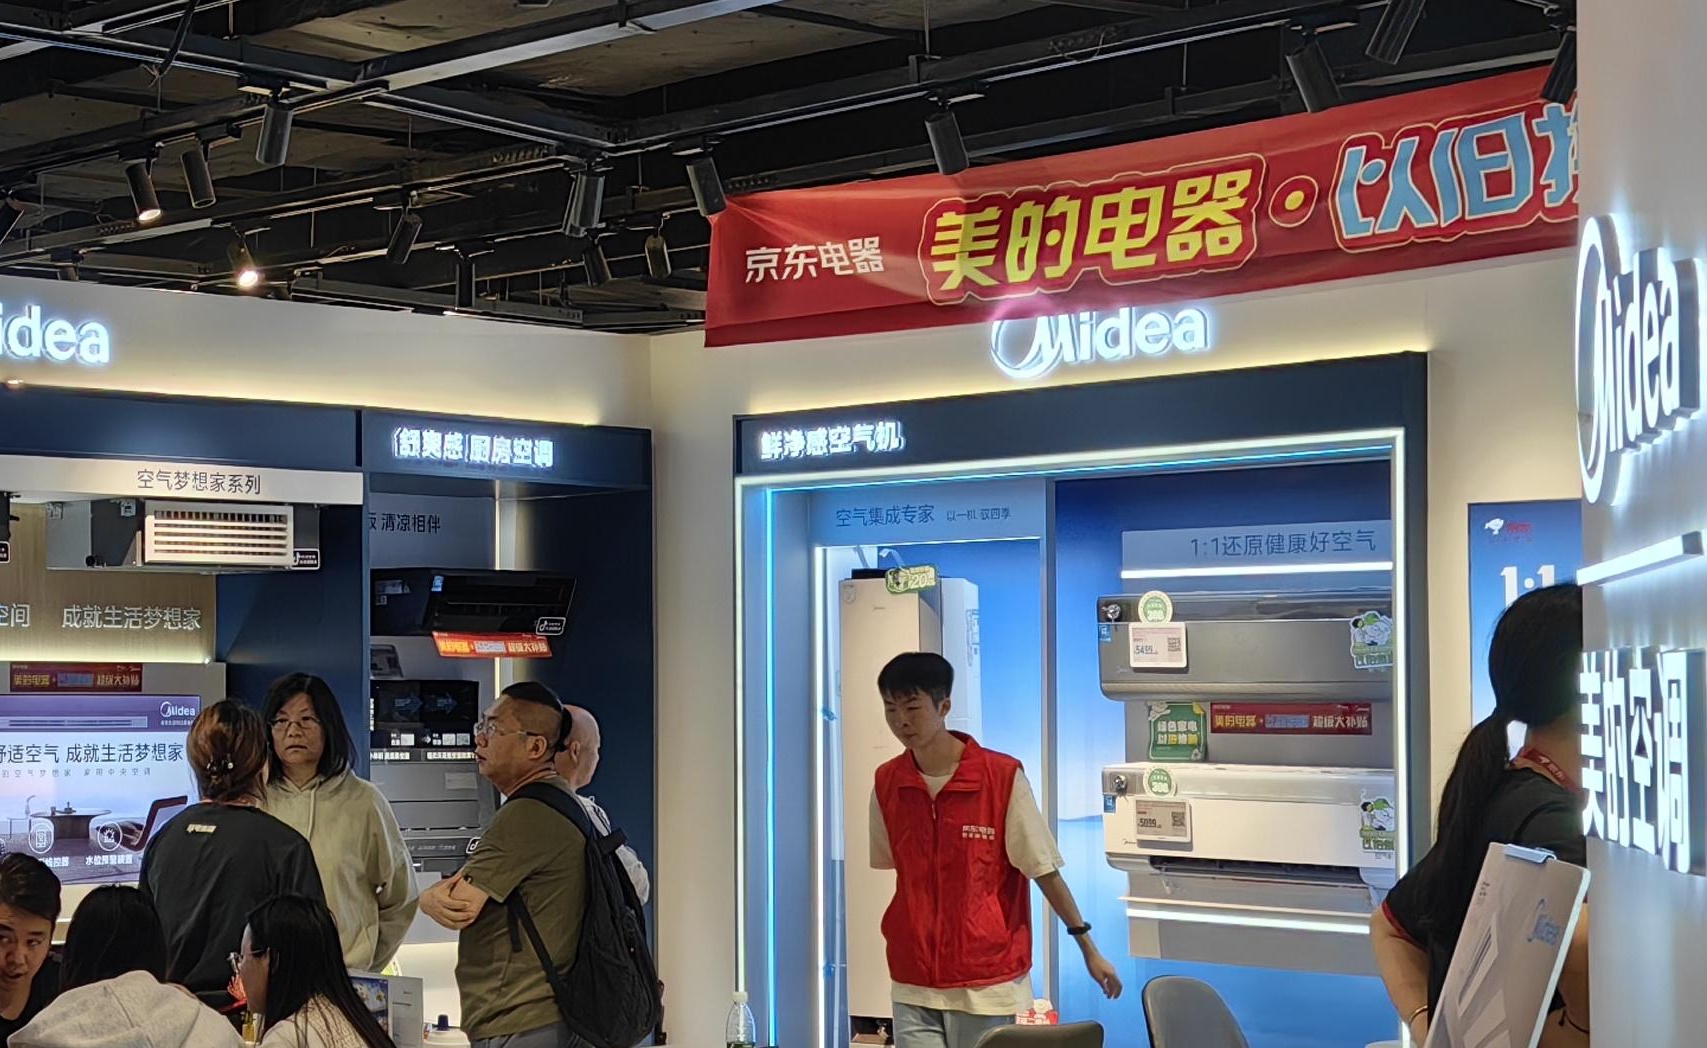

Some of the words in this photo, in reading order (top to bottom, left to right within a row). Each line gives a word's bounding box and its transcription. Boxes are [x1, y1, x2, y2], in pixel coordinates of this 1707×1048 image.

[929, 168, 1255, 292] 美的电器
[745, 237, 885, 284] 京东电器
[990, 307, 1210, 379] Midea
[1575, 217, 1680, 503] Midea
[760, 420, 902, 460] 鲜净感空气机
[137, 468, 261, 496] 空气梦想家系列
[836, 504, 934, 527] 空气集成专家
[1190, 530, 1375, 556] 1:1还原健康好空气
[62, 605, 201, 631] 成就生活梦想家
[160, 701, 196, 718] Midea
[66, 743, 184, 764] 成就生活梦想家
[1580, 649, 1690, 873] 美的空调
